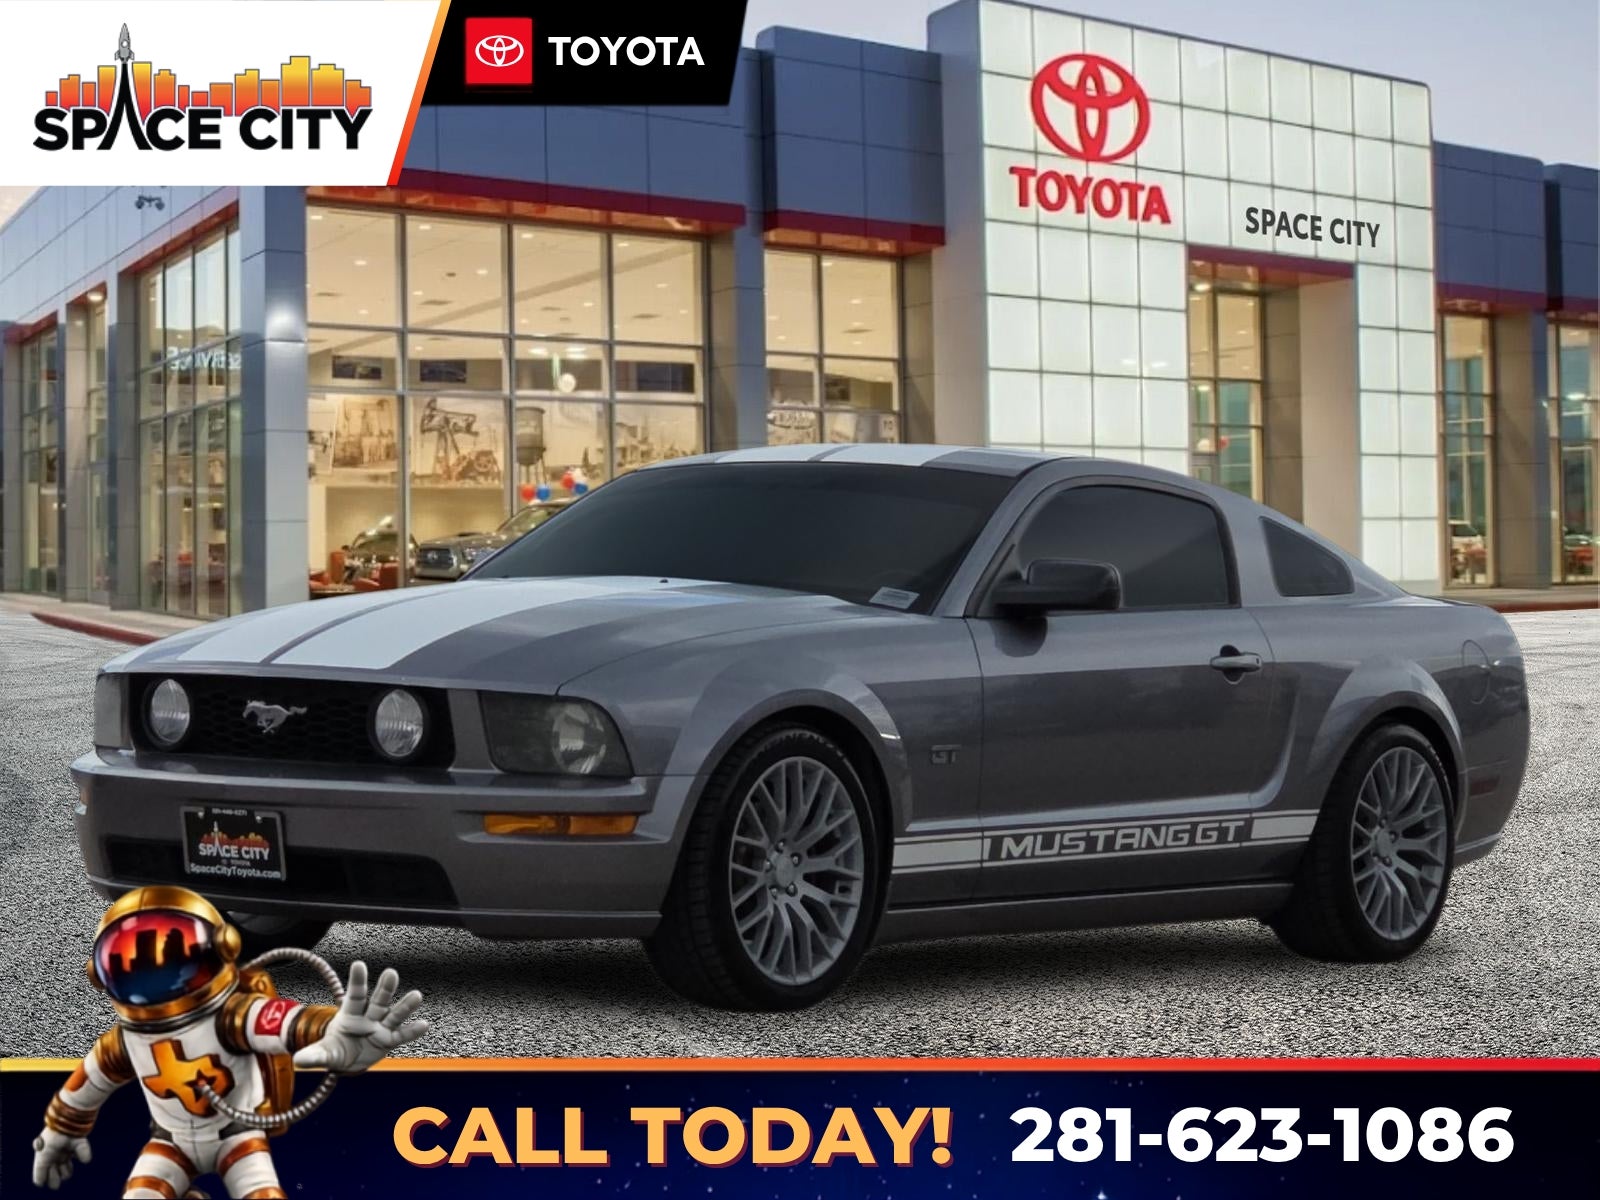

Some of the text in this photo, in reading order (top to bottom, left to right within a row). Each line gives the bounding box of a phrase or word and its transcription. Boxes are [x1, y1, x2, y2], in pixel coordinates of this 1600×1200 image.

[1009, 166, 1171, 224] TOYOTA
[1245, 207, 1381, 248] SPACE CITY
[930, 744, 962, 765] GT
[198, 842, 269, 860] SPACE CITY
[1000, 820, 1245, 859] MUSTANG GT
[190, 863, 281, 879] SpaceCityToyota.com
